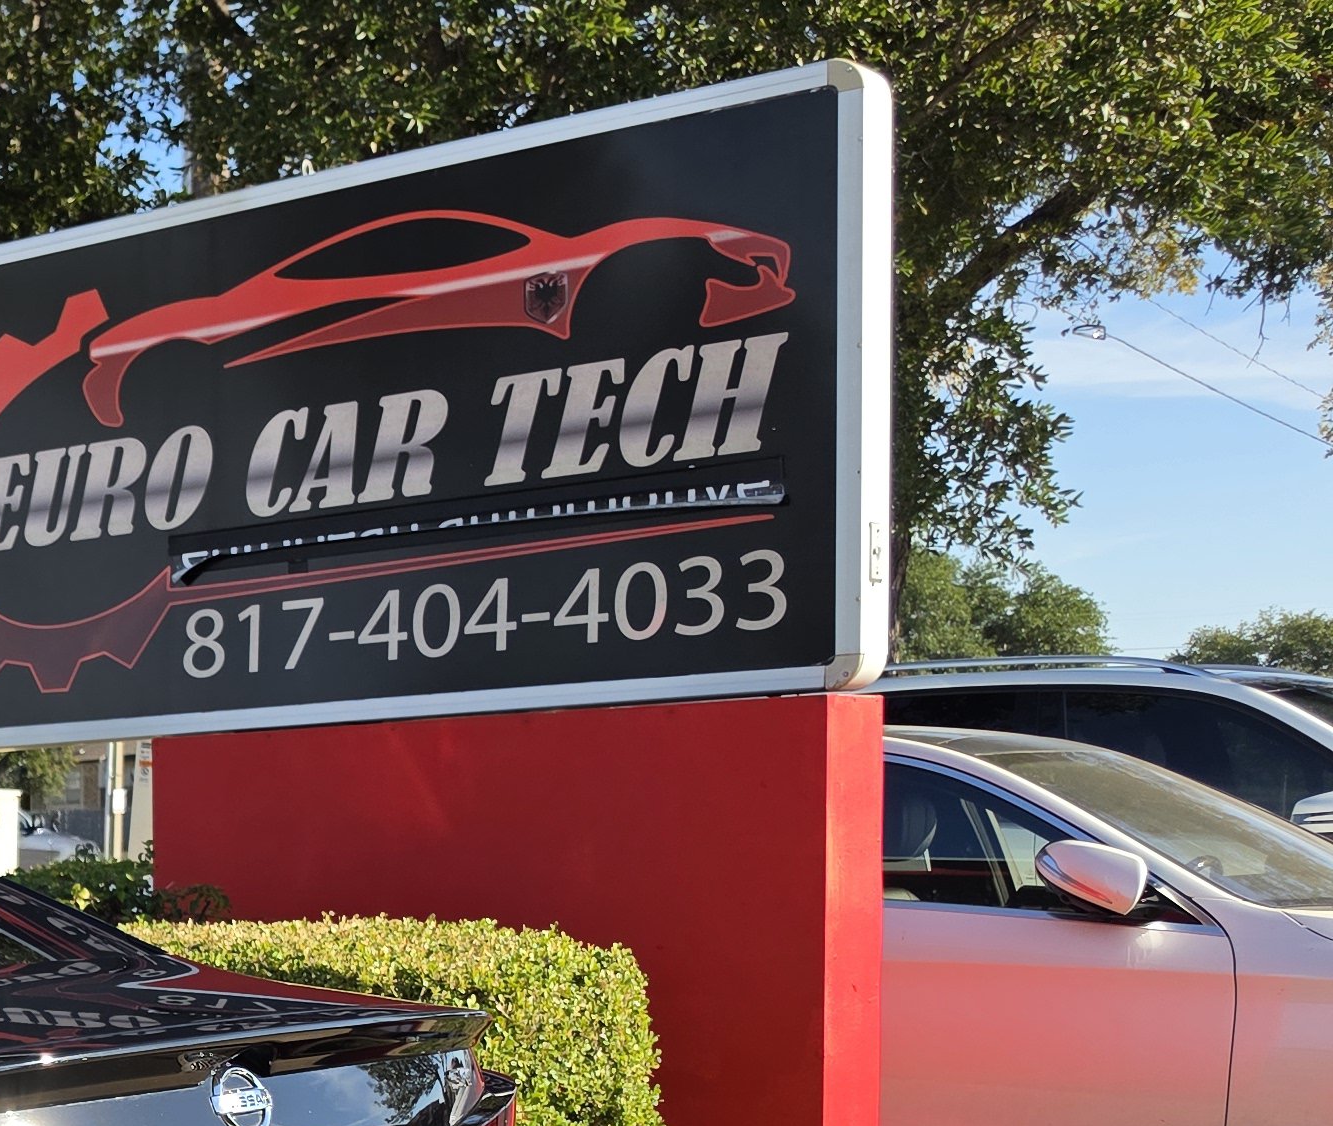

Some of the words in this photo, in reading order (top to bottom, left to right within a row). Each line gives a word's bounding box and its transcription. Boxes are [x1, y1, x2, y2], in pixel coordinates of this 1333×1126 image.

[245, 387, 449, 519] CAR
[482, 331, 790, 490] TECH
[181, 548, 788, 679] 817-404-4033
